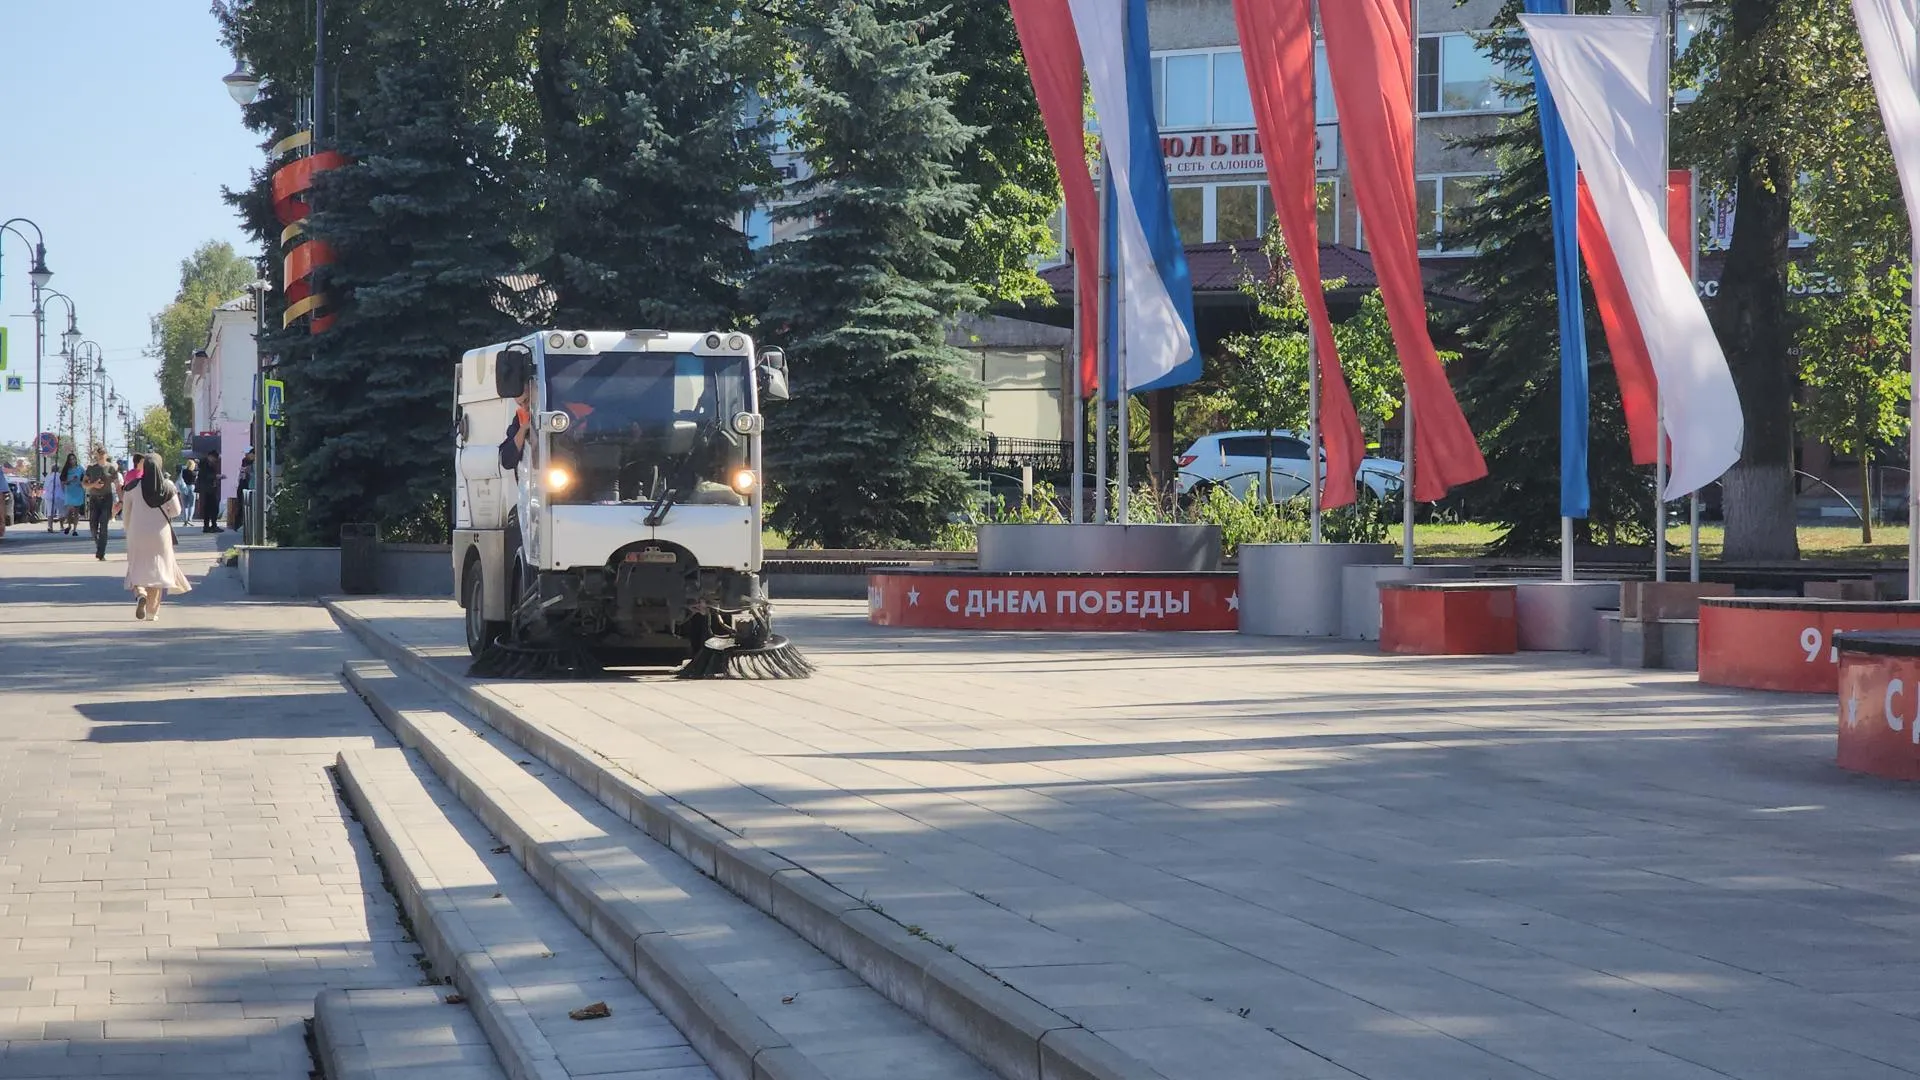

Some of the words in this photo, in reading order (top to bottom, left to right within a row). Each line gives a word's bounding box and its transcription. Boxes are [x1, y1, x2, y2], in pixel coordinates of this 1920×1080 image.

[1177, 161, 1205, 172] СЕТЬ
[1210, 160, 1264, 171] САЛОНОВ
[945, 590, 960, 613] С
[964, 589, 1047, 617] ДНЕМ
[1056, 589, 1190, 618] ПОБЕДЫ
[1800, 627, 1822, 662] 9
[1885, 678, 1904, 732] С
